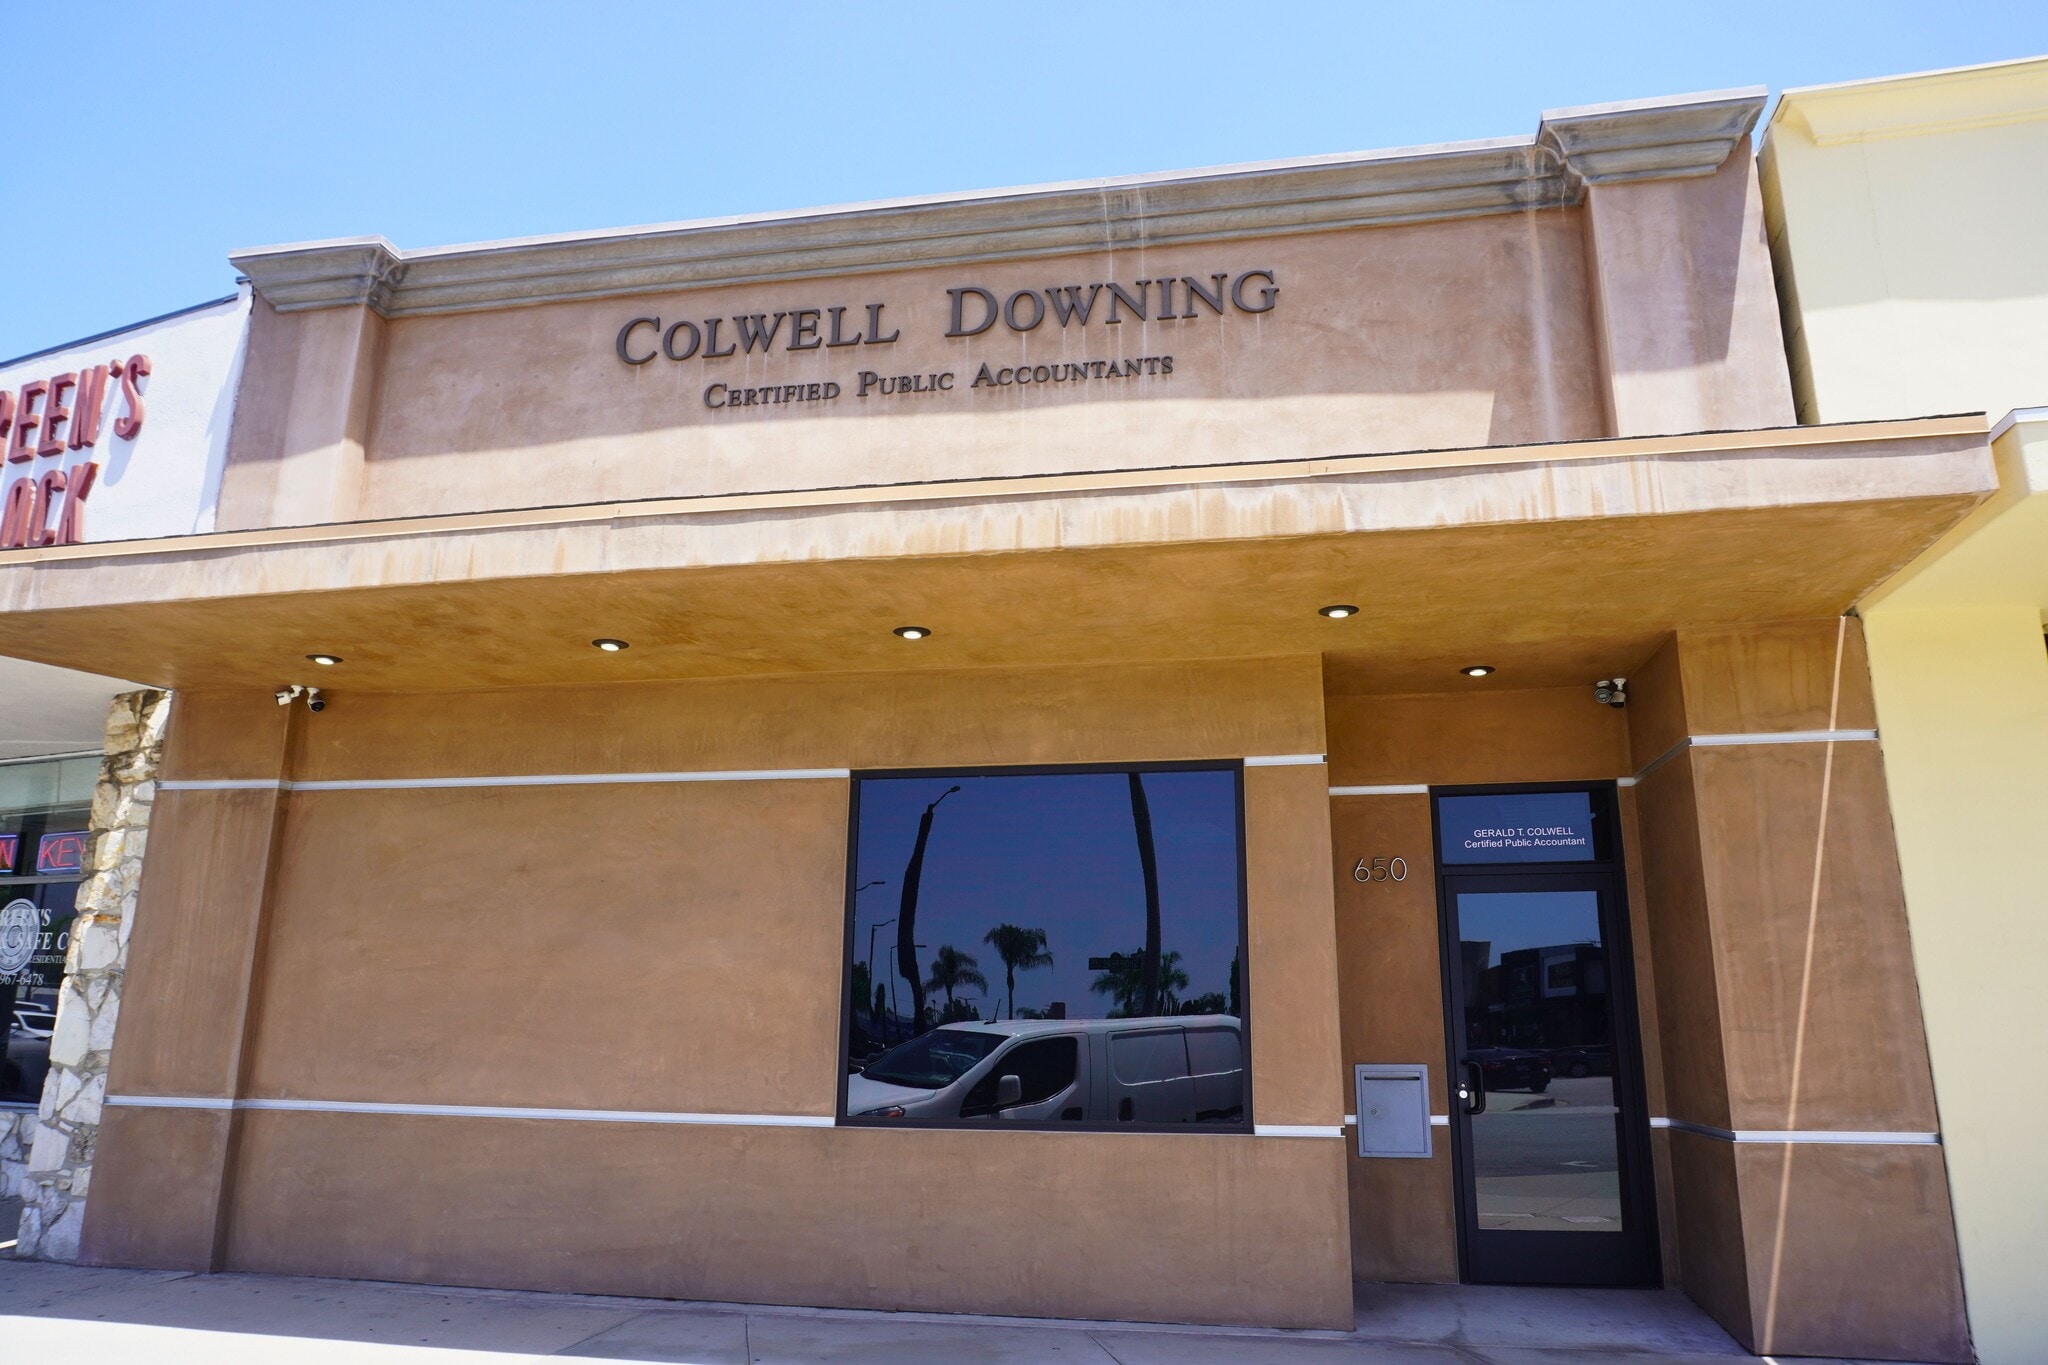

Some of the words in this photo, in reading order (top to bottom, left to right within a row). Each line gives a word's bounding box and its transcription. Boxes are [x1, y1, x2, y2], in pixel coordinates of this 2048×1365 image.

[616, 303, 900, 365] COLWELL
[945, 269, 1280, 338] DOWNING
[703, 380, 841, 409] CERTIFIED
[857, 370, 954, 397] PUBLIC
[970, 355, 1174, 388] ACCOUNTANTS
[1464, 839, 1503, 849] Certified
[1505, 838, 1532, 847] Public
[1534, 837, 1586, 846] Accountant
[1474, 829, 1515, 838] GERALD
[1517, 828, 1525, 837] T.
[1527, 827, 1574, 836] COLWELL
[1354, 857, 1407, 882] 650
